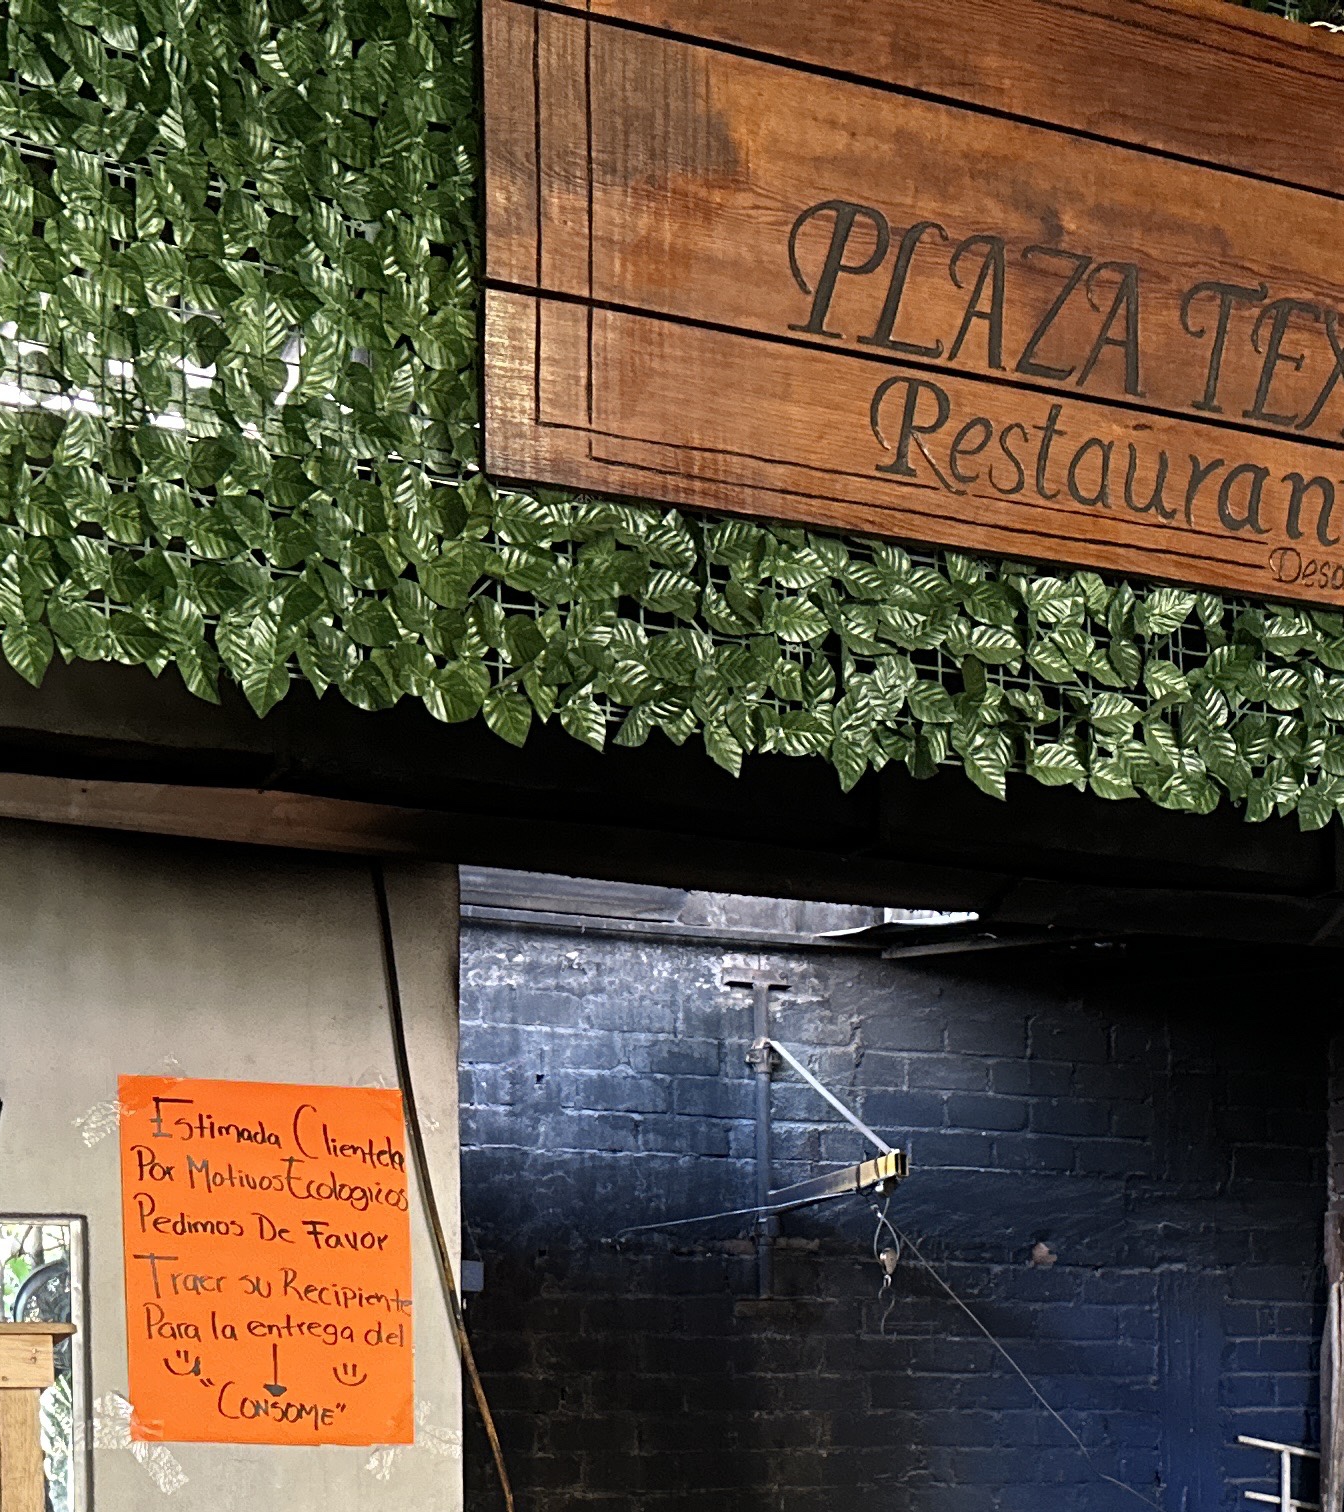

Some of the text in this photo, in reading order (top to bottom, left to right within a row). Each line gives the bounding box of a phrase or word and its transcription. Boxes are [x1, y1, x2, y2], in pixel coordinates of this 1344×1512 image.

[787, 200, 1145, 397] PLAZA
[150, 1096, 405, 1173] Estimada Clientela
[130, 1144, 409, 1212] Por Motivos Ecologicos
[132, 1192, 389, 1252] Pedimos De Favor
[133, 1252, 413, 1318] Traer su Recipiente
[142, 1302, 404, 1348] Para la entrega del
